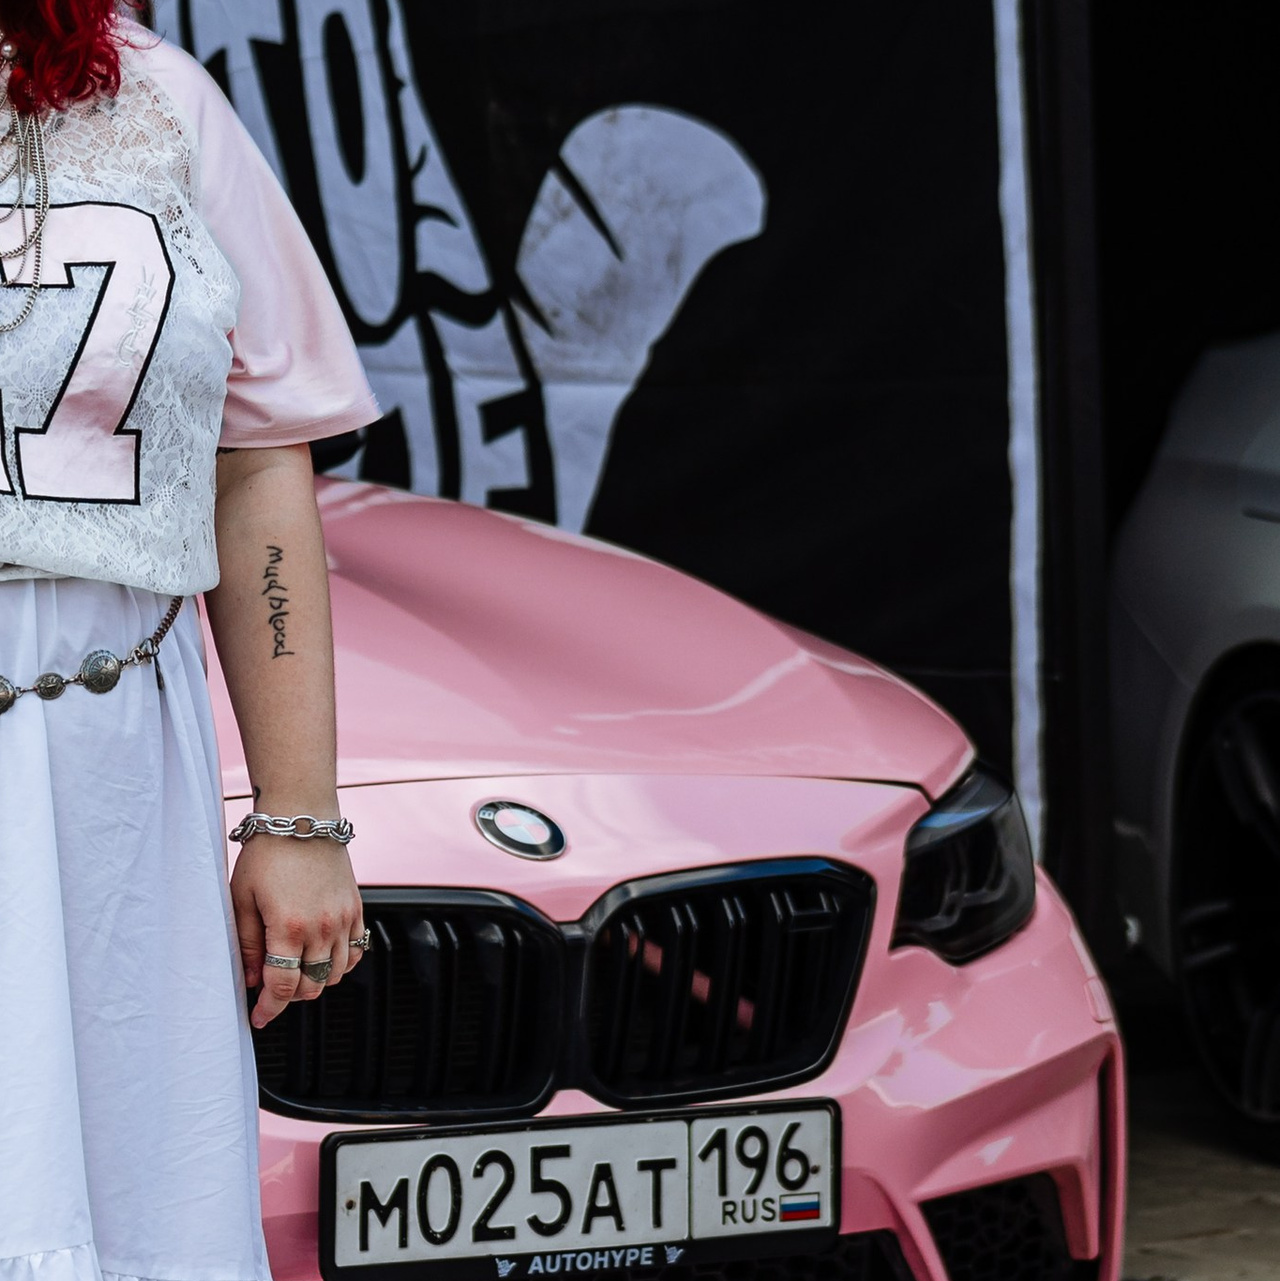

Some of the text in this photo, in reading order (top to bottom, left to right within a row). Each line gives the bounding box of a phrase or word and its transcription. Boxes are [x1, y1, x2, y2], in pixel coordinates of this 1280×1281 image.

[698, 1122, 811, 1197] 196
[721, 1198, 777, 1226] RUS
[527, 1247, 653, 1275] AUTOHYPE
